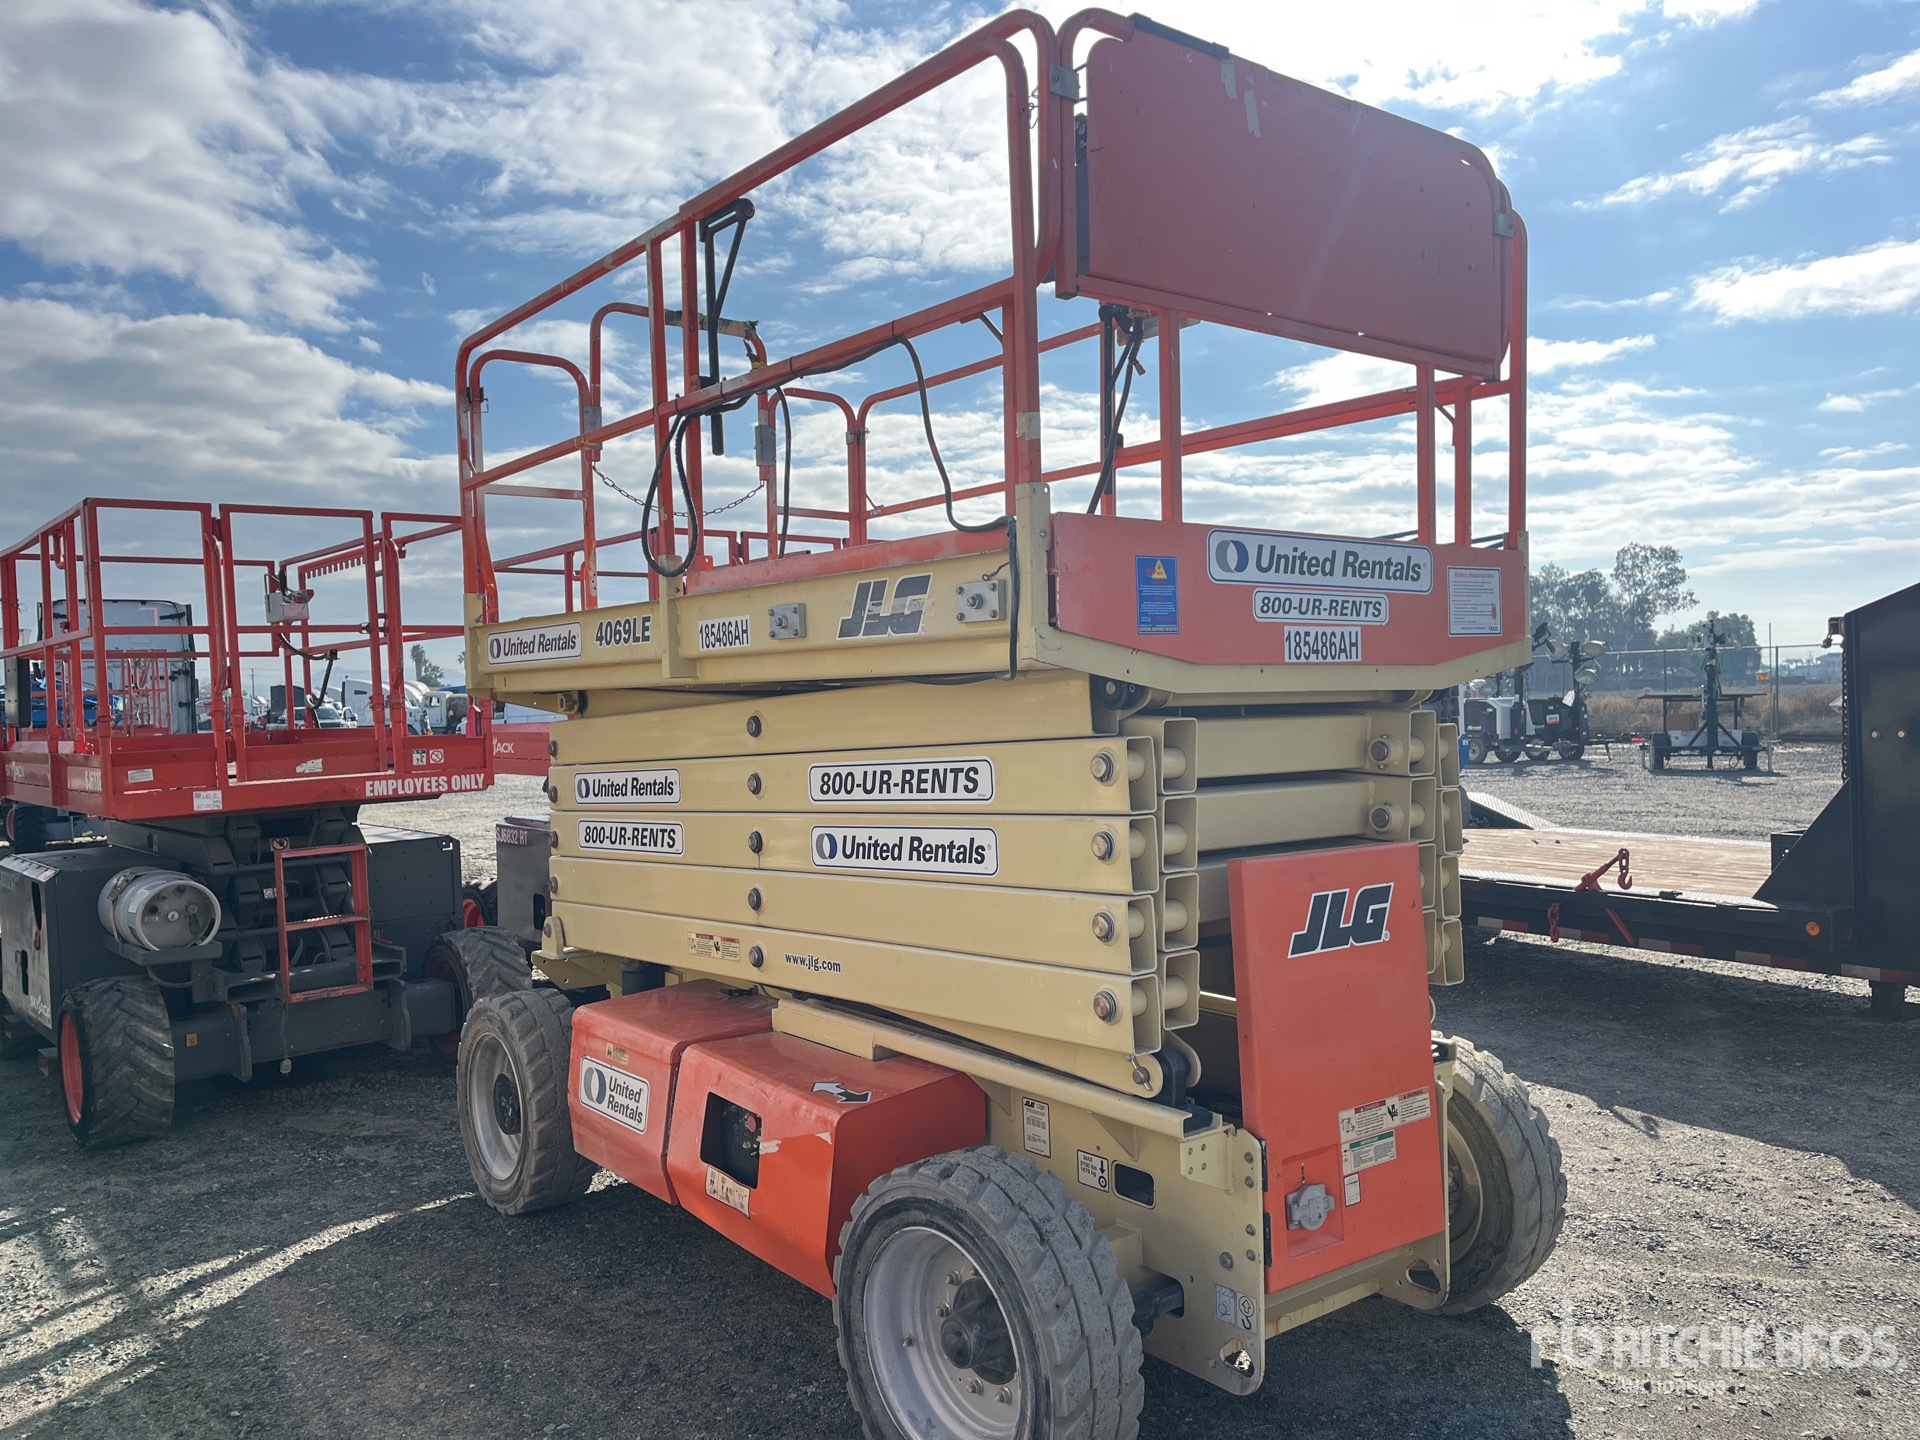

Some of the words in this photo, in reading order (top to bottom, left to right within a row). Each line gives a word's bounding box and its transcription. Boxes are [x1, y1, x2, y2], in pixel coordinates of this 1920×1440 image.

[1255, 543, 1337, 577] United
[1341, 550, 1422, 582] Rentals
[837, 572, 933, 640] JLG
[1260, 596, 1382, 618] 800-UR-RENTS
[503, 634, 535, 657] United
[537, 630, 576, 653] Rentals
[595, 615, 651, 647] 4069LE
[700, 618, 749, 649] 185486AH
[1285, 630, 1359, 661] 185486AH
[365, 776, 448, 797] EMPLOYEES
[451, 773, 485, 790] ONLY
[592, 777, 628, 797] United
[630, 775, 674, 796] Rentals
[819, 766, 979, 795] 800-UR-RENTS
[520, 830, 528, 845] RT
[584, 825, 676, 849] 800-UR-RENTS
[841, 835, 904, 861] United
[908, 836, 986, 865] Rentals
[1288, 882, 1394, 958] JLG
[785, 953, 841, 973] www.jlg.com
[608, 1076, 642, 1104] United
[606, 1094, 643, 1124] Rentals
